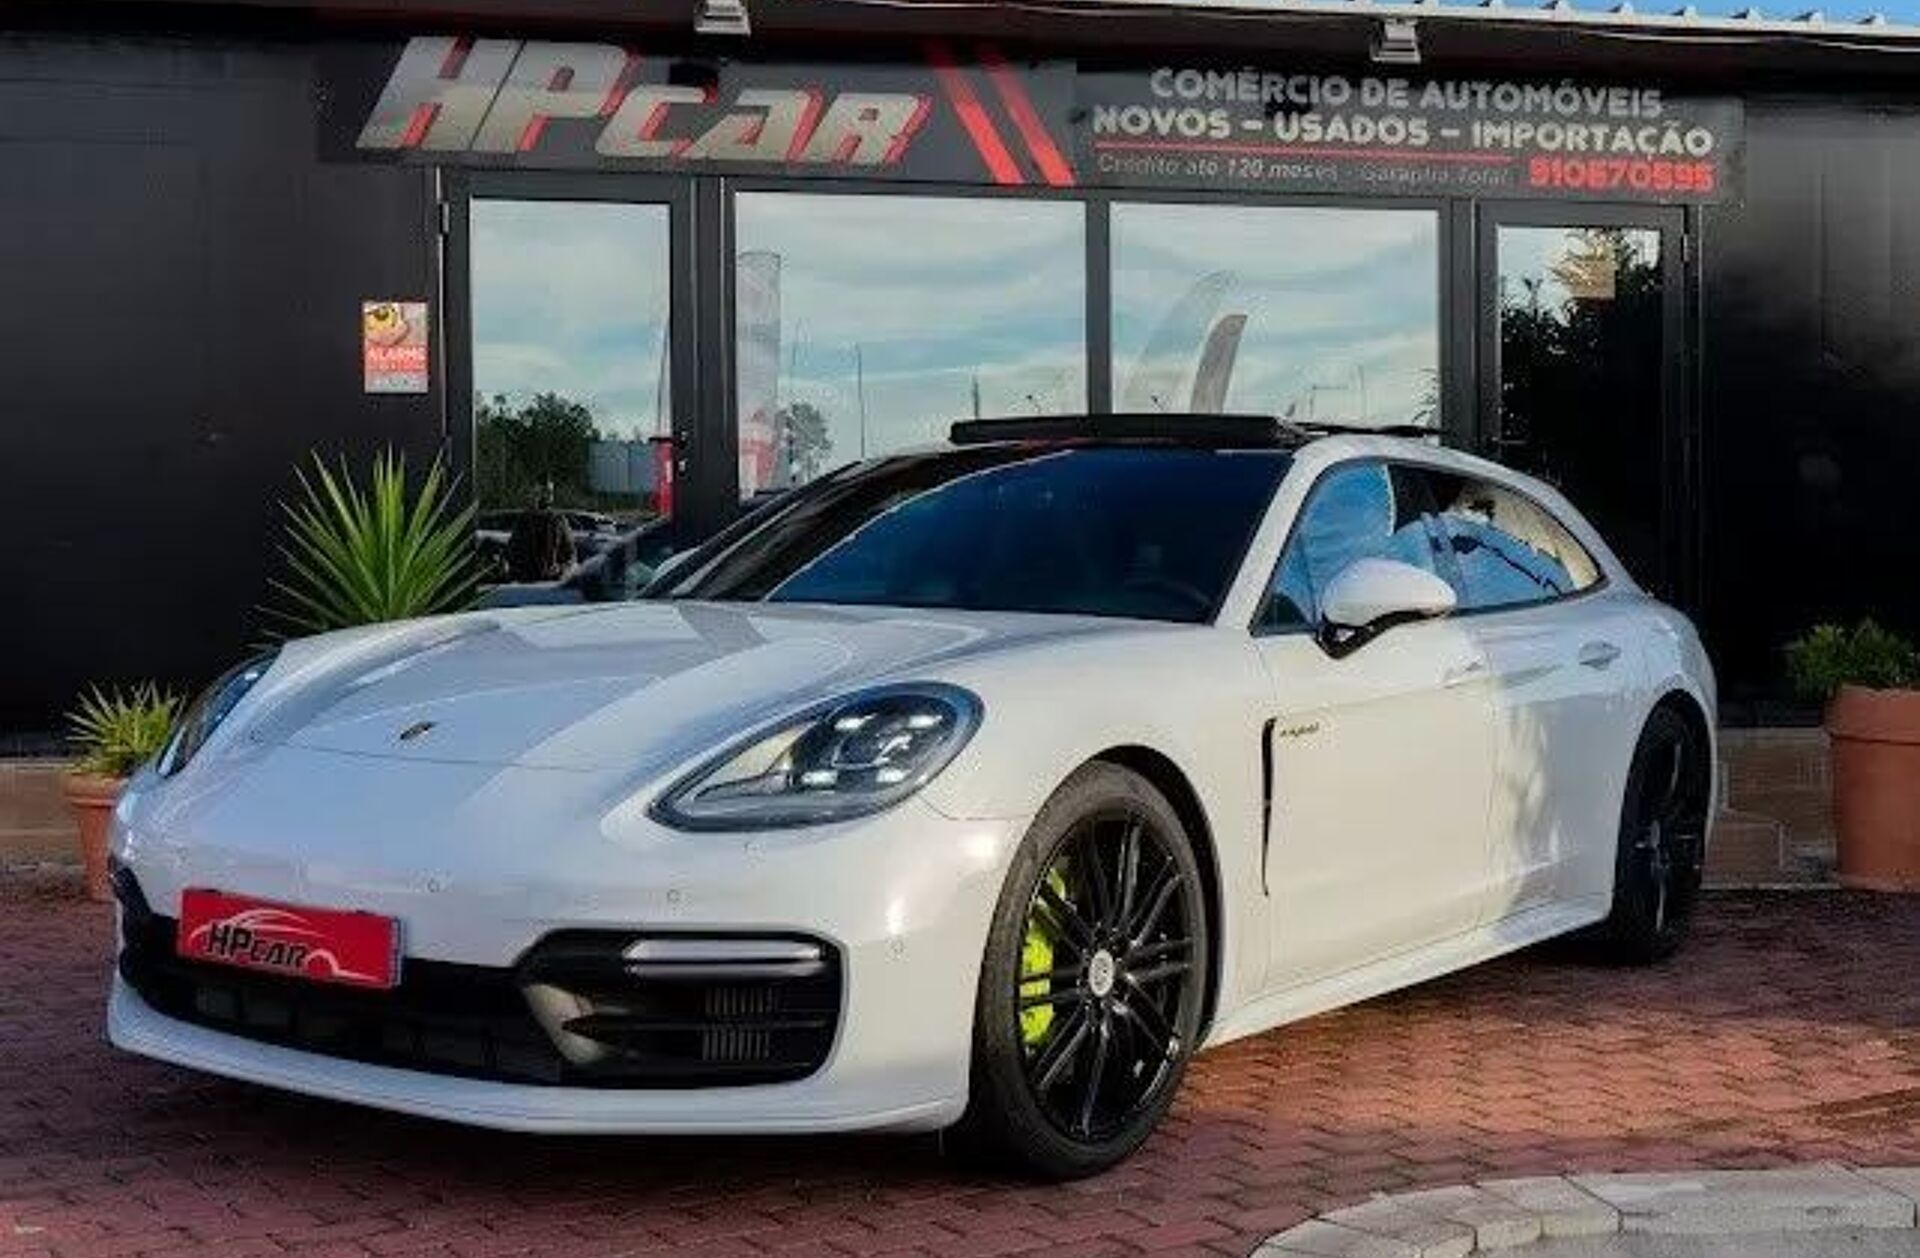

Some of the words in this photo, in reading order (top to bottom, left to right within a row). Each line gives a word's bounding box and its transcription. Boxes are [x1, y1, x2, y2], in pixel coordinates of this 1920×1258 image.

[1151, 67, 1350, 105] COMÉRCIO
[1361, 77, 1410, 108] DE
[1420, 79, 1663, 118] AUTOMÓVEIS
[1094, 105, 1231, 138] NOVOS
[1274, 111, 1429, 146] USADOS
[1472, 120, 1714, 160] IMPORTAÇÃO
[1227, 158, 1263, 179] 120
